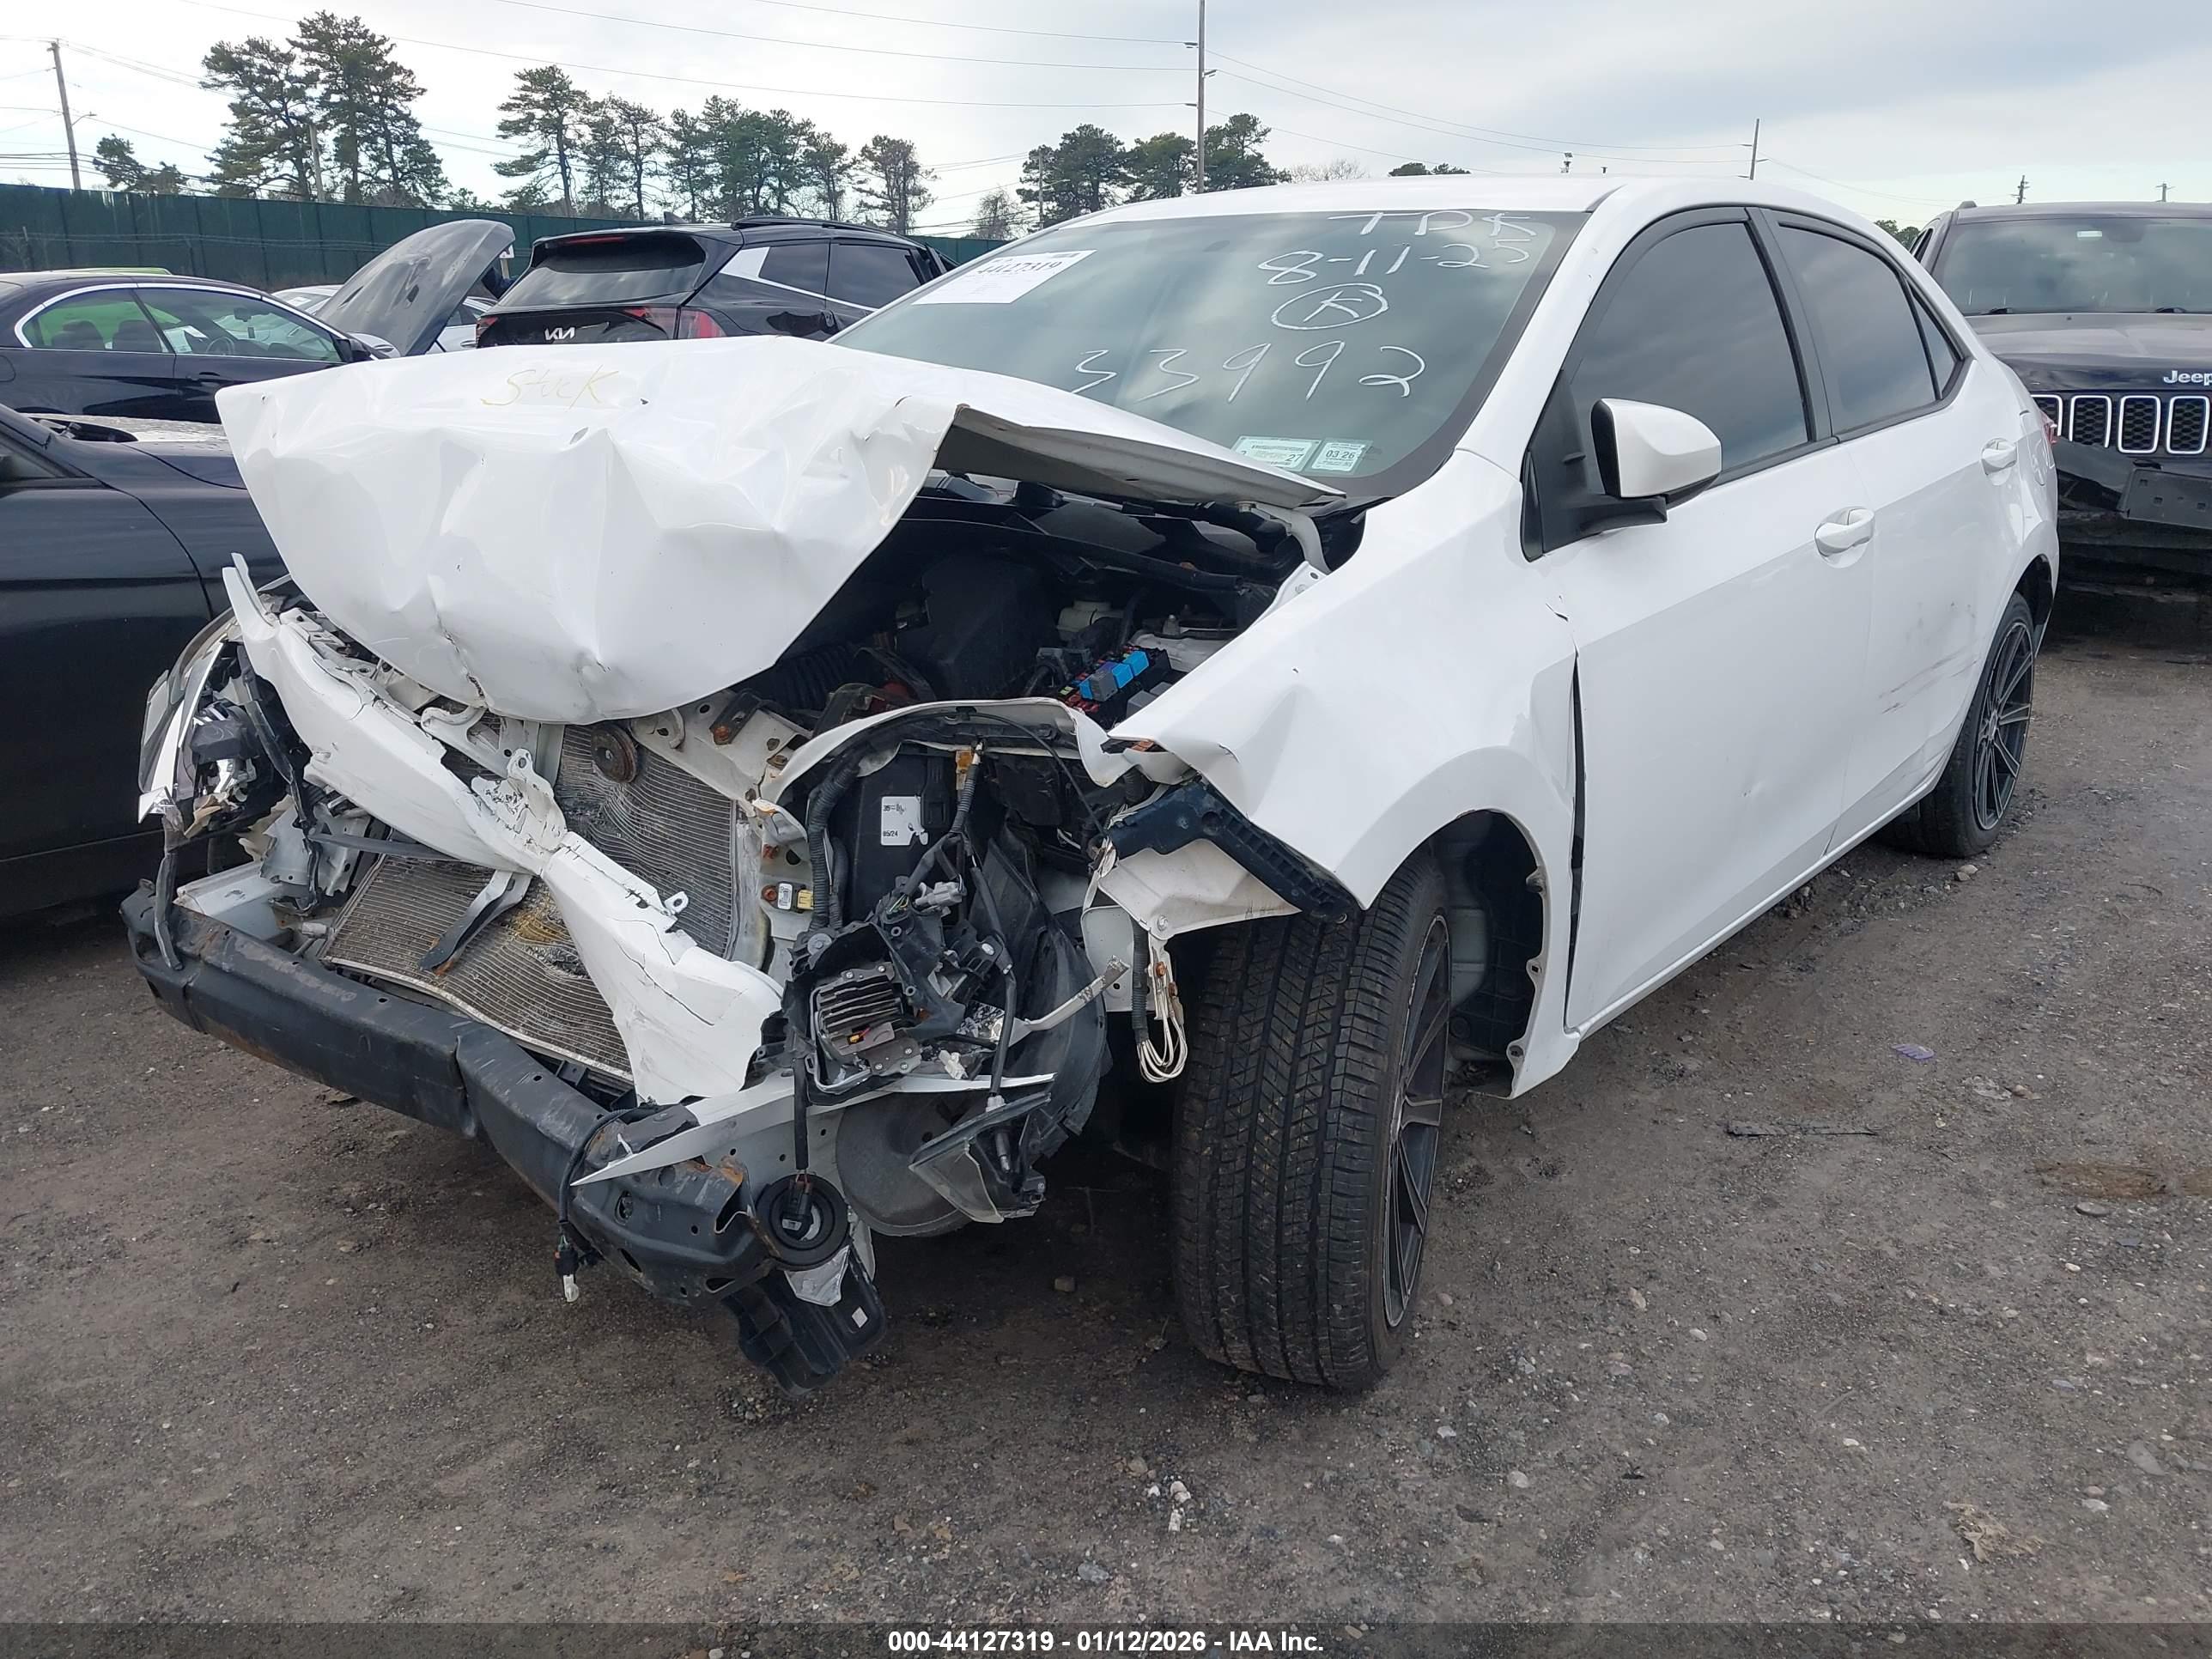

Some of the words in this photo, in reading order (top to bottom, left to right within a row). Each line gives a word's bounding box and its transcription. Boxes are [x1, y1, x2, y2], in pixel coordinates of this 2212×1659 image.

[1257, 239, 1531, 285] 8-11-25
[544, 326, 575, 341] KIA
[1325, 449, 1340, 459] 03
[1341, 451, 1356, 459] 26
